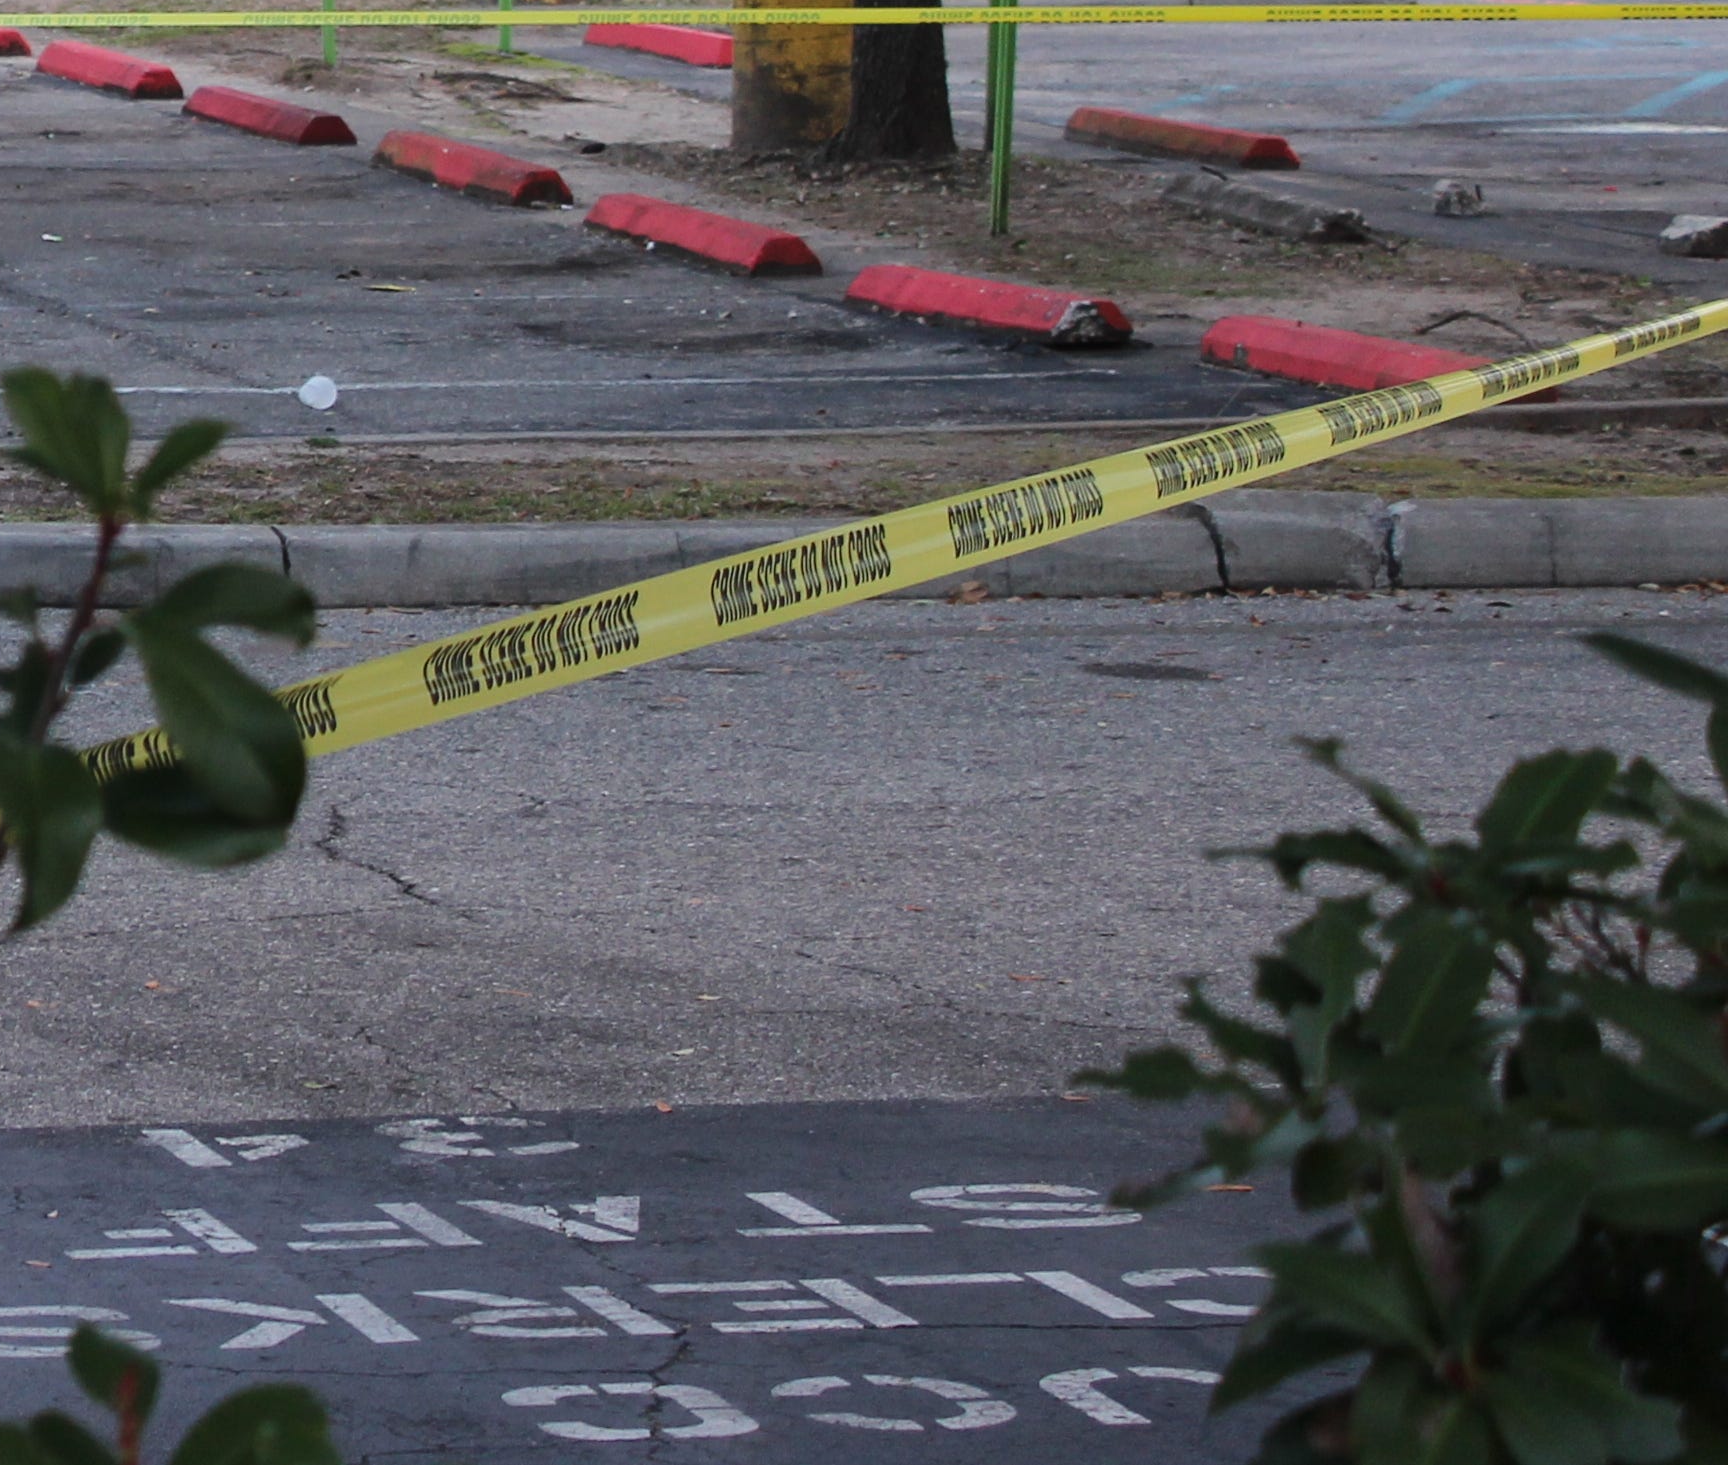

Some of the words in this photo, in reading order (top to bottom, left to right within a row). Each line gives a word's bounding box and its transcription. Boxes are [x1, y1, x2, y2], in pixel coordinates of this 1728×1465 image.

[947, 494, 990, 559] CRIME
[985, 485, 1027, 546] SCENE
[1021, 482, 1044, 535] DO
[1039, 476, 1066, 530] NOT
[1060, 468, 1104, 523] CROSS
[710, 561, 758, 626] CRIME
[756, 548, 797, 612] SCENE
[800, 542, 822, 598] DO
[821, 535, 846, 592] NOT
[848, 523, 891, 586] CROSS
[422, 633, 481, 706] CRIME
[479, 621, 533, 690] SCENE
[531, 614, 556, 673] DO
[559, 605, 590, 668] NOT
[588, 590, 640, 660] CROSS
[63, 1182, 1143, 1261] STAFF
